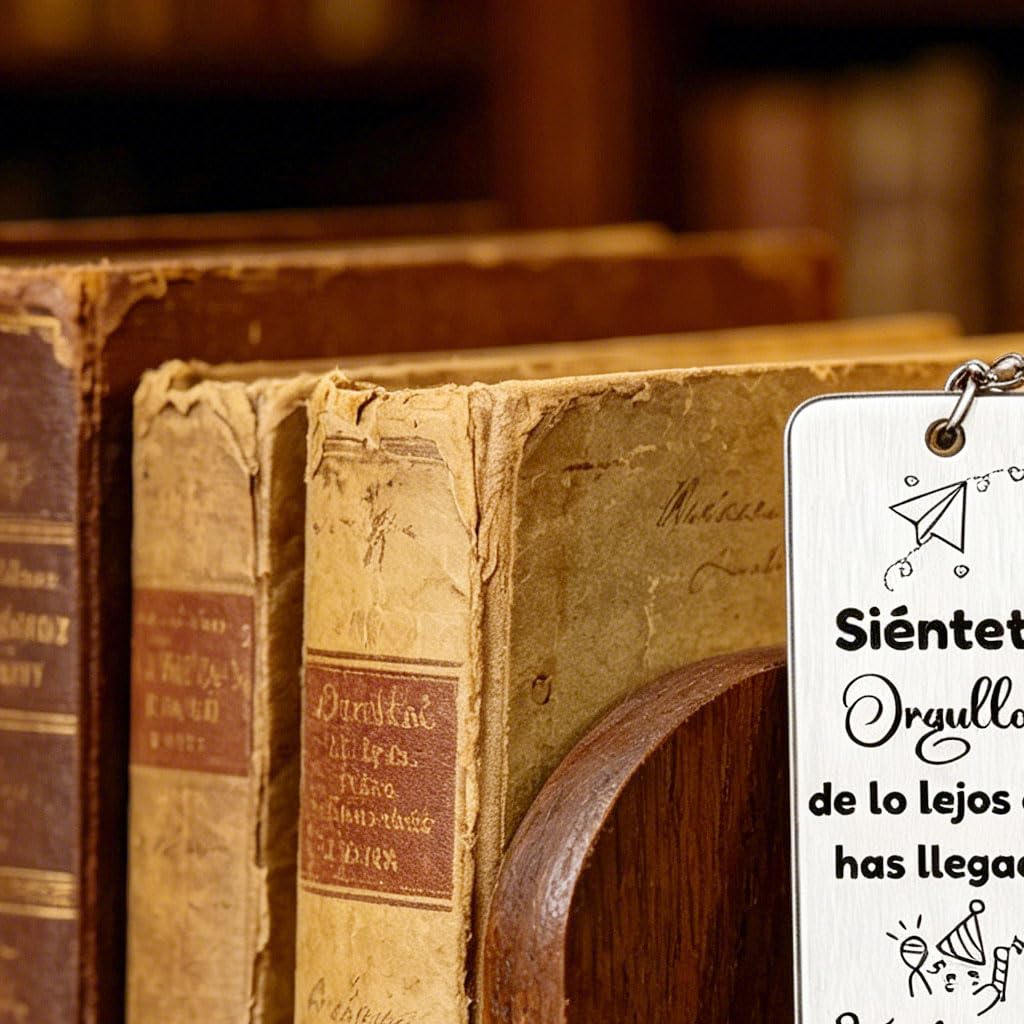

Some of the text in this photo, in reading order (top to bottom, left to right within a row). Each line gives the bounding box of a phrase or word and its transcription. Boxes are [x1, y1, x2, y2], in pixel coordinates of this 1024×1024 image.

[808, 780, 856, 817] de
[869, 779, 908, 817] lo
[919, 779, 1011, 826] lejos
[835, 844, 906, 881] has
